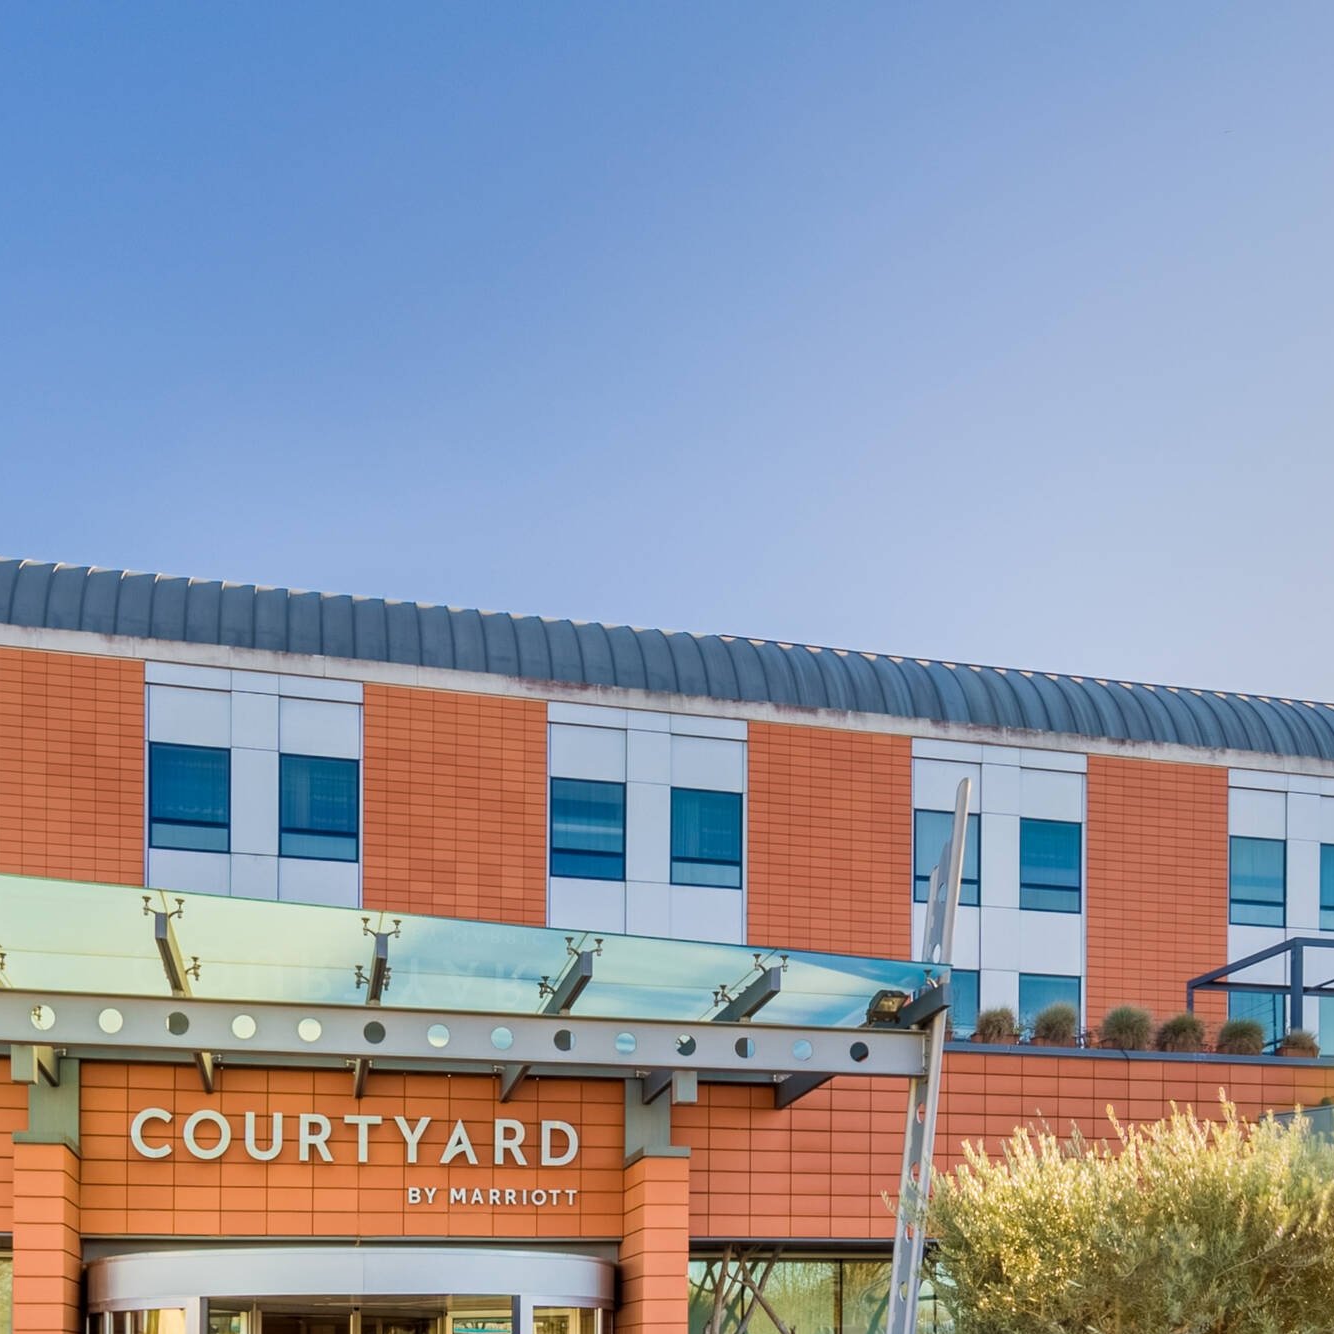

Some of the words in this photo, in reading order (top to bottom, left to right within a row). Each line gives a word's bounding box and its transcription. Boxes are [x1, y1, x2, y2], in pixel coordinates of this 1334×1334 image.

[130, 1107, 579, 1167] COURTYARD
[407, 1186, 437, 1205] BY
[450, 1187, 578, 1206] MARRIOTT
